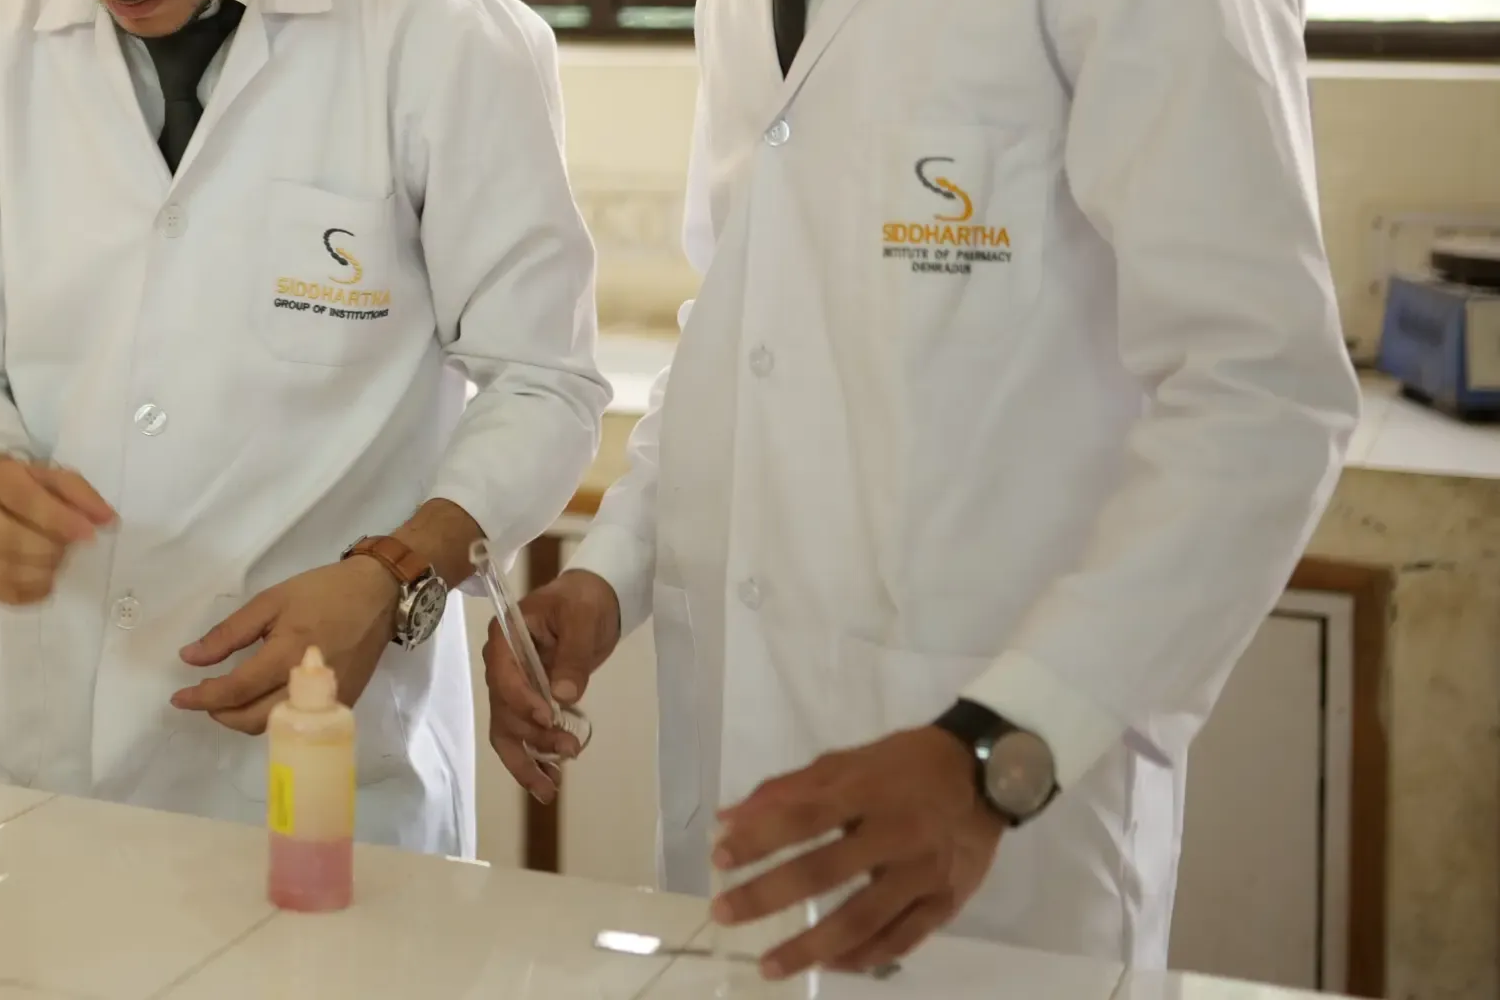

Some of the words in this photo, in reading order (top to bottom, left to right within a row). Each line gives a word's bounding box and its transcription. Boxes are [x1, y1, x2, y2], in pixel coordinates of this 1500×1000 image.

[882, 223, 1010, 247] SIDDHARTHA
[934, 248, 950, 261] OF
[275, 277, 390, 306] SIDDHARTHA
[274, 298, 310, 311] GROUP
[312, 305, 327, 314] OF
[329, 308, 389, 320] INSTITUTIONS
